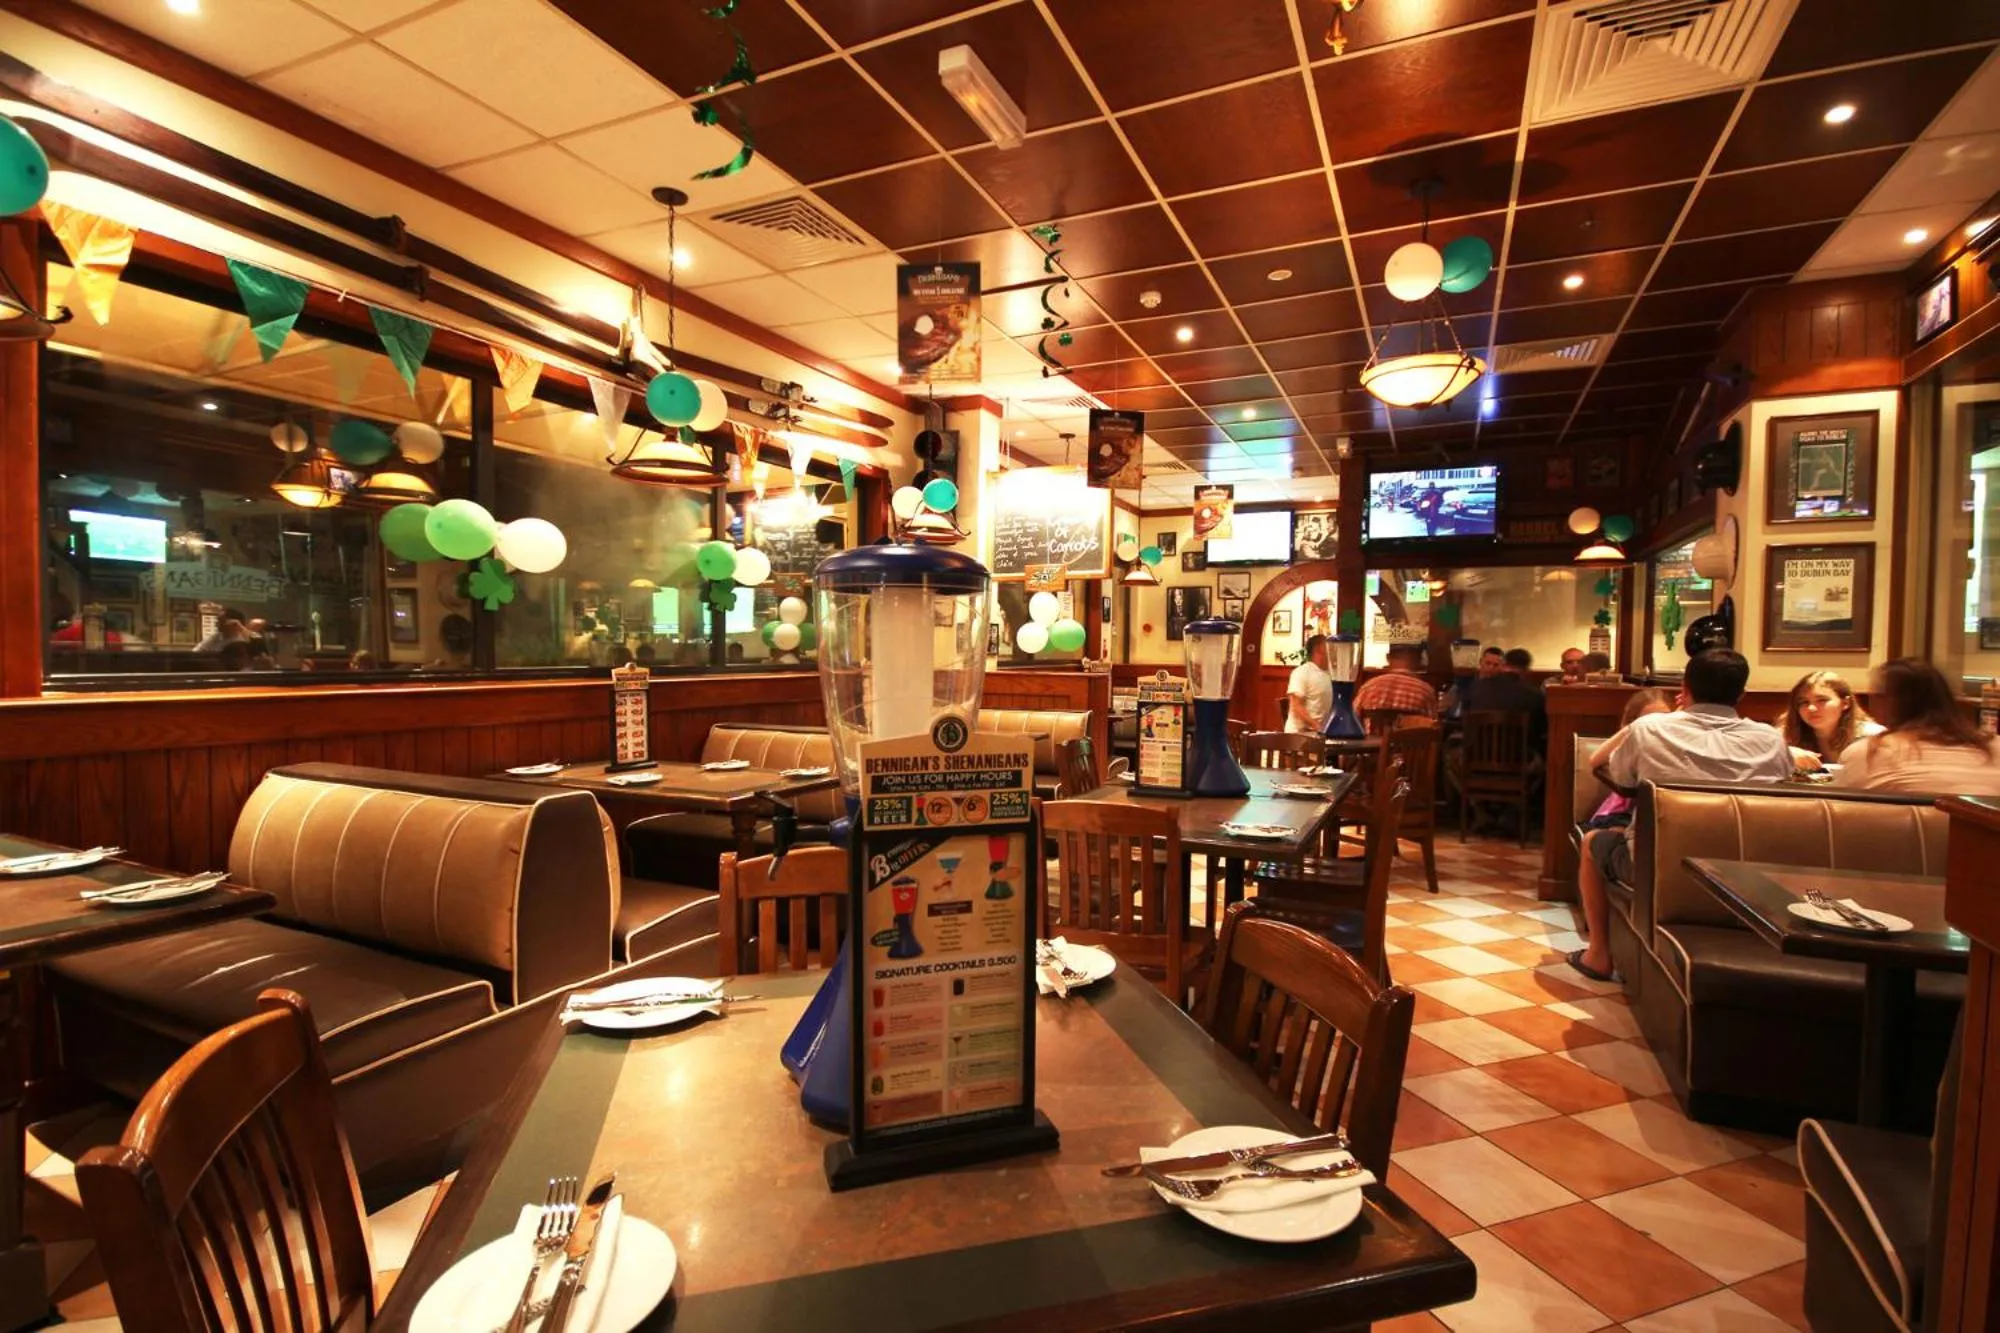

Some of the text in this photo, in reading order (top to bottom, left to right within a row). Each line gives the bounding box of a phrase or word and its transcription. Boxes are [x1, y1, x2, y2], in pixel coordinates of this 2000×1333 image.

[1800, 561, 1814, 569] ON
[1816, 560, 1829, 569] MY
[1832, 560, 1851, 568] WAY
[1800, 569, 1831, 577] DUBLIN
[1832, 569, 1850, 577] BAY
[865, 753, 1029, 774] BENNIGAN'S SHENANIGANS
[882, 771, 1013, 786] JOIN US FOR HAPPY HOURS
[992, 792, 1022, 805] 25%
[875, 964, 932, 980] SIGNATURE
[934, 959, 986, 973] COCKTAILS
